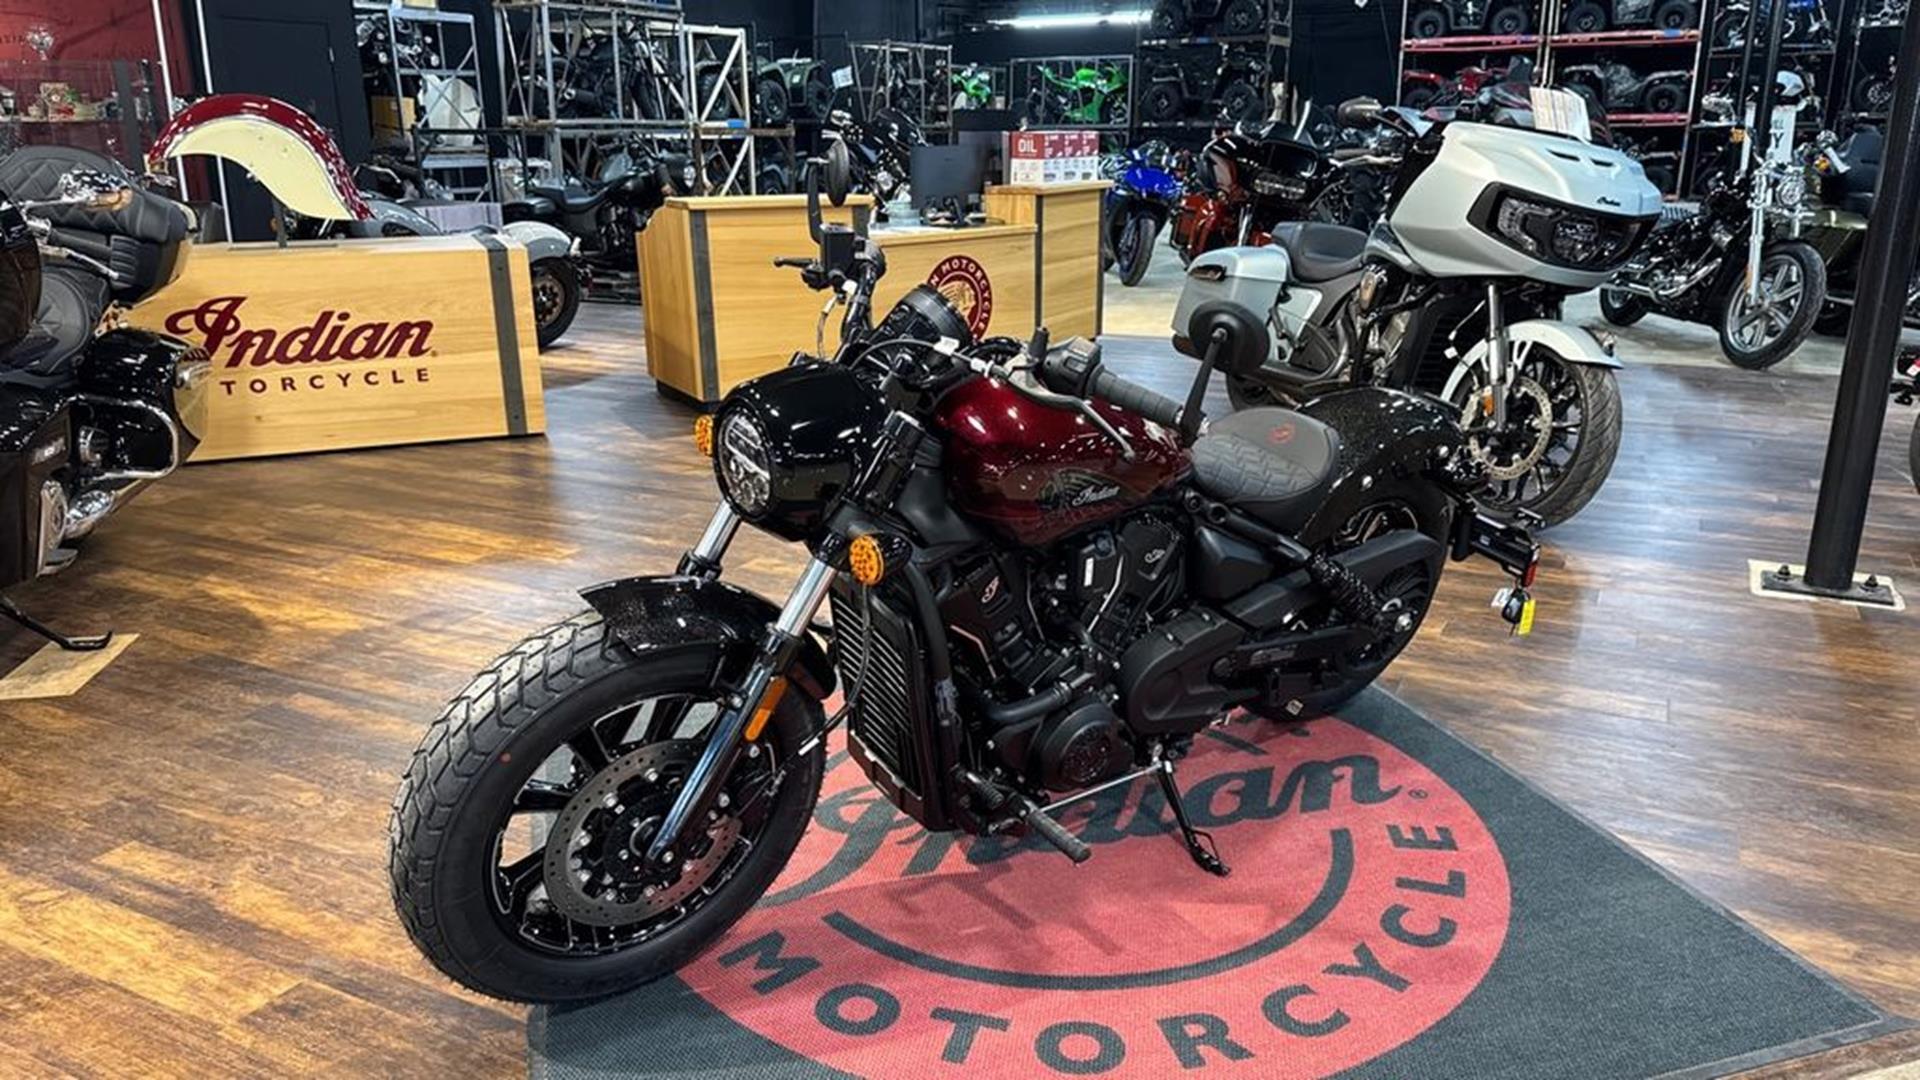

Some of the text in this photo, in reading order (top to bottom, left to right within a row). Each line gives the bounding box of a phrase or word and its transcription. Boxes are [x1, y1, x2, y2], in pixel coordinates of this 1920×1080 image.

[1018, 139, 1037, 153] OIL
[164, 296, 433, 369] Indian
[219, 367, 430, 396] TORCYCLE
[717, 823, 1467, 1075] MOTORCYCLE
